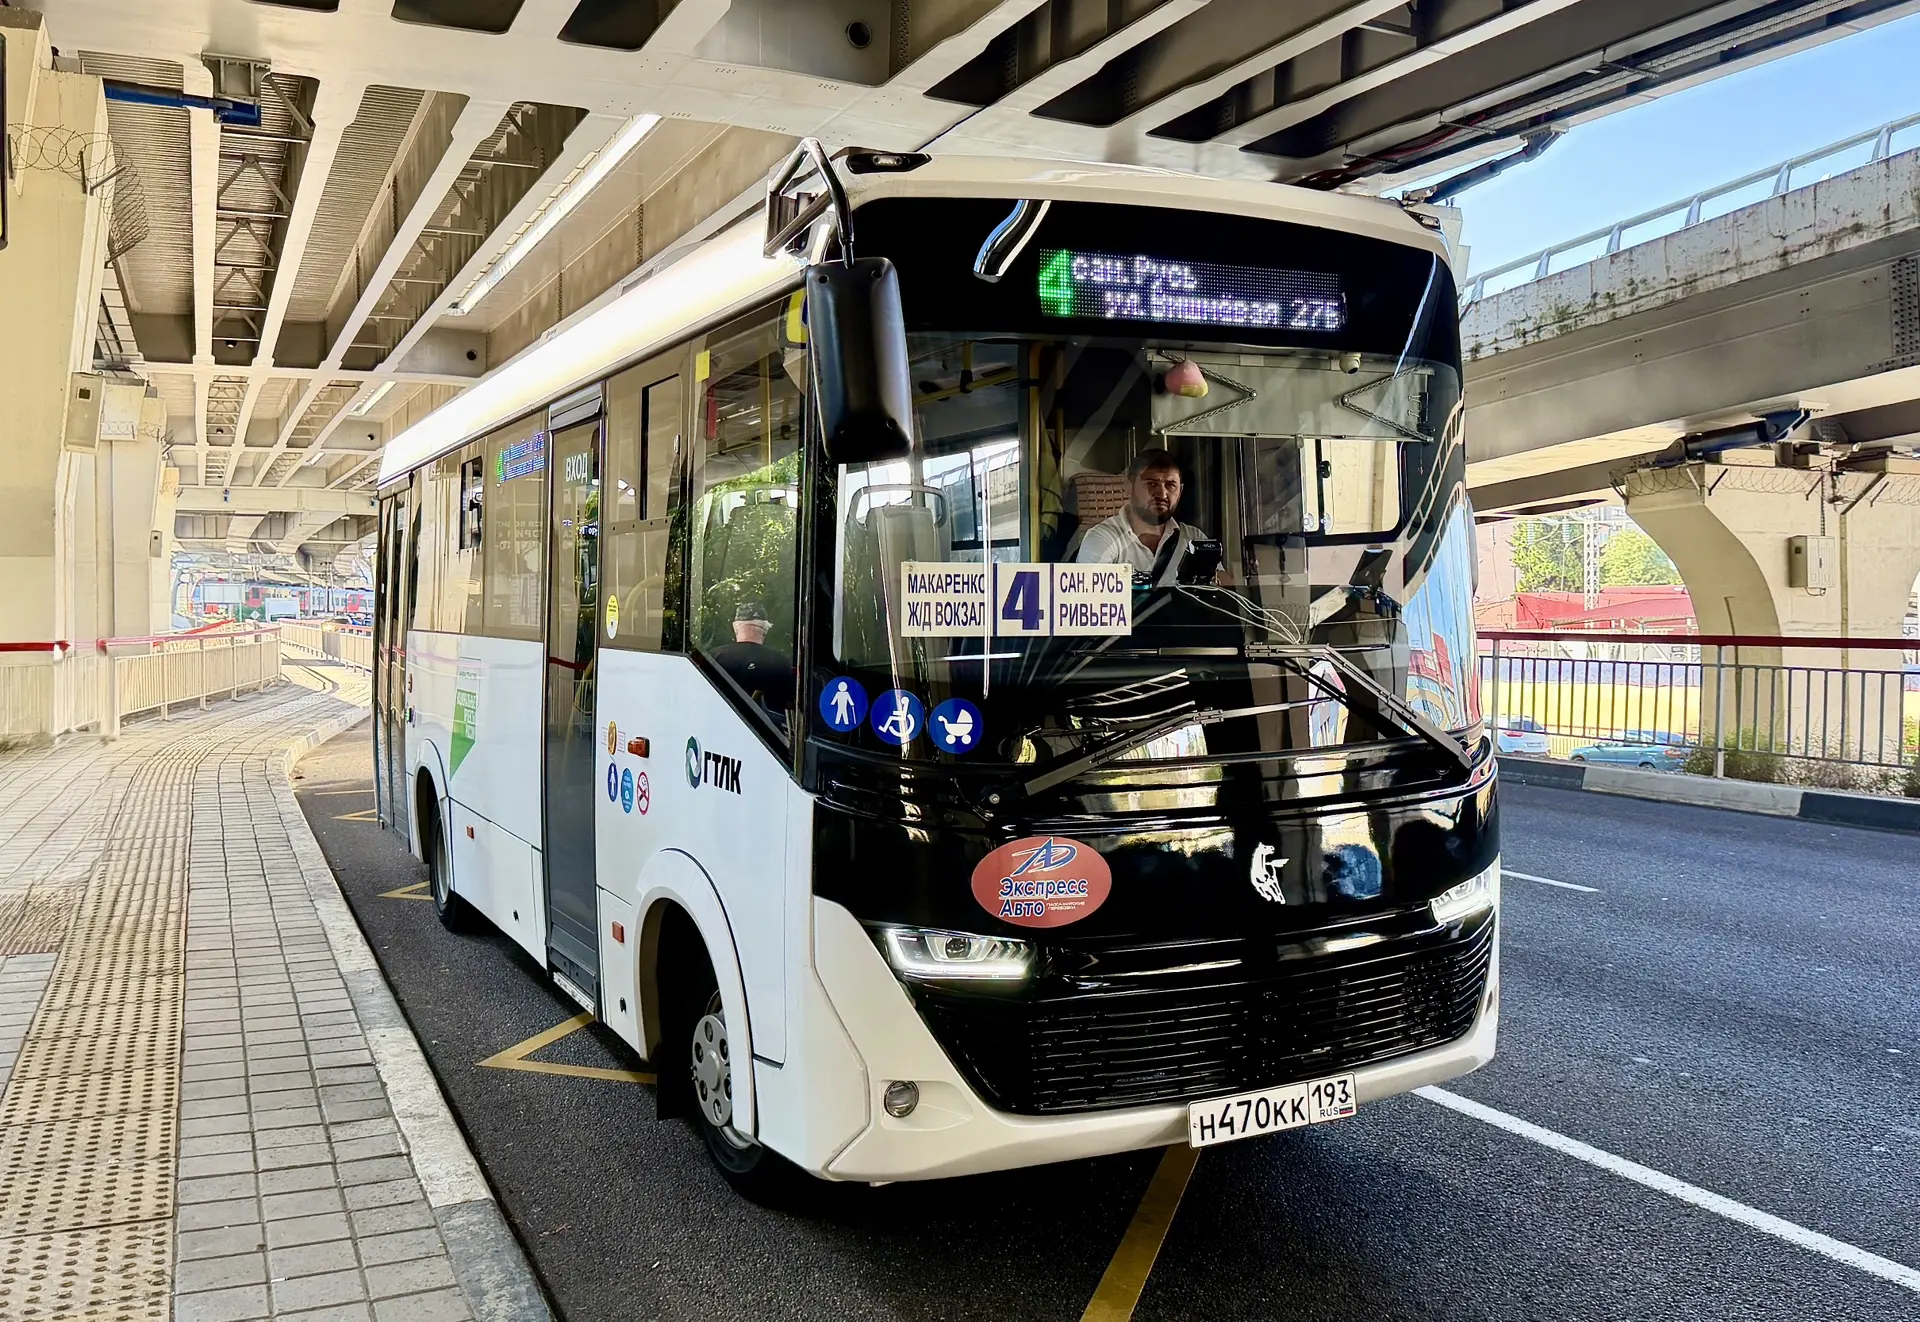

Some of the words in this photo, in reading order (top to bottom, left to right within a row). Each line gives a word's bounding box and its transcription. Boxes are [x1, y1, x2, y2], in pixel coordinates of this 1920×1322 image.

[1039, 249, 1071, 315] 4
[566, 452, 588, 484] ВХОД
[907, 573, 985, 594] МАКАРЕНКО
[1059, 571, 1088, 593] САН.
[1092, 572, 1124, 593] РУСЬ
[1001, 571, 1044, 630] 4
[907, 601, 932, 631] Ж/Д
[935, 601, 985, 627] ВОКЗАЛ
[1059, 603, 1127, 627] РИВЬЕРА
[703, 750, 742, 795] ГТЛК
[999, 877, 1088, 899] Экспресс
[999, 899, 1045, 917] Авто
[1200, 1096, 1306, 1141] Н470КК
[1311, 1079, 1350, 1109] 193
[1319, 1108, 1339, 1119] RUS
